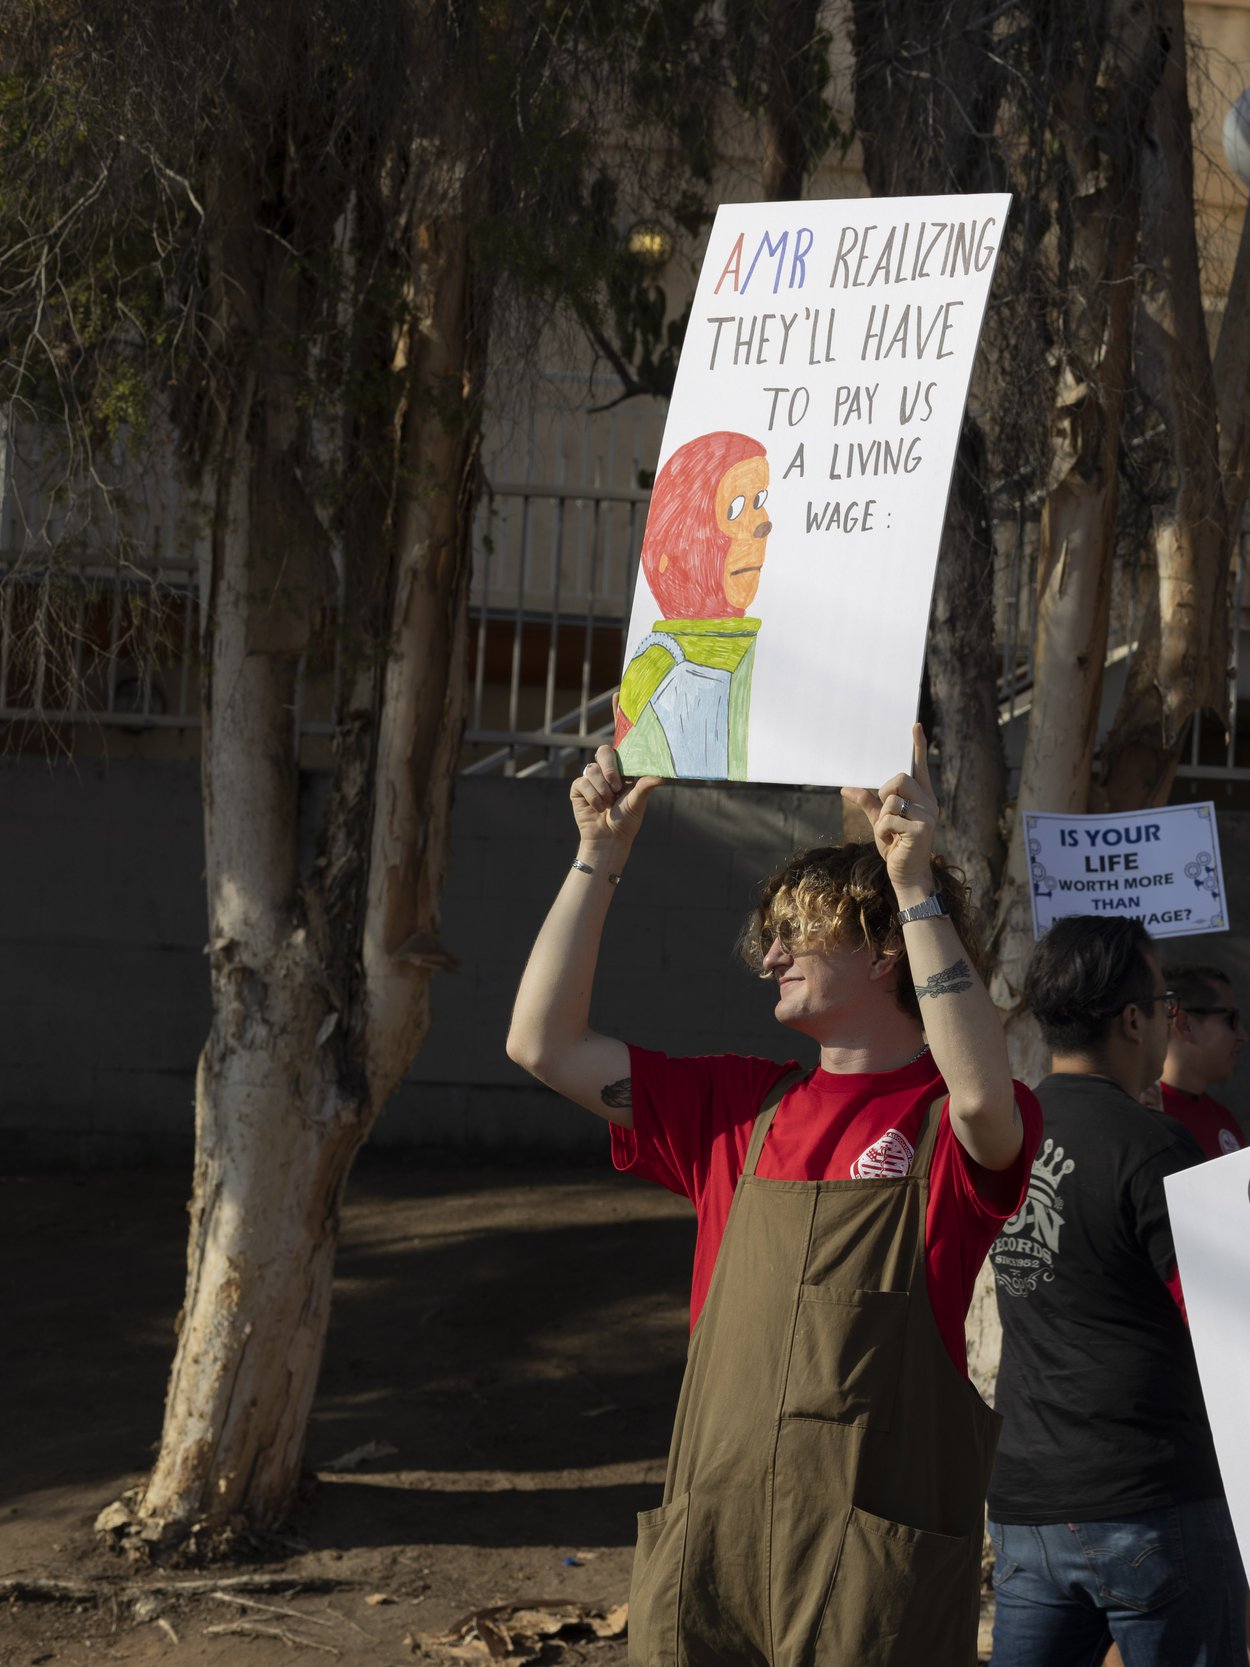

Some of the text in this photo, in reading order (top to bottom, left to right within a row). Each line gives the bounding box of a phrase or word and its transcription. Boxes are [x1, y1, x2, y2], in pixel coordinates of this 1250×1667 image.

[713, 217, 996, 295] AMR REALIZING
[706, 300, 964, 371] THEY'LL HAVE
[763, 380, 938, 431] TO PAY US
[782, 437, 922, 480] A LIVING
[1059, 824, 1161, 847] IS YOUR
[1084, 852, 1139, 873] LIFE
[1058, 873, 1174, 892] WORTH MORE
[1091, 896, 1141, 911] THAN
